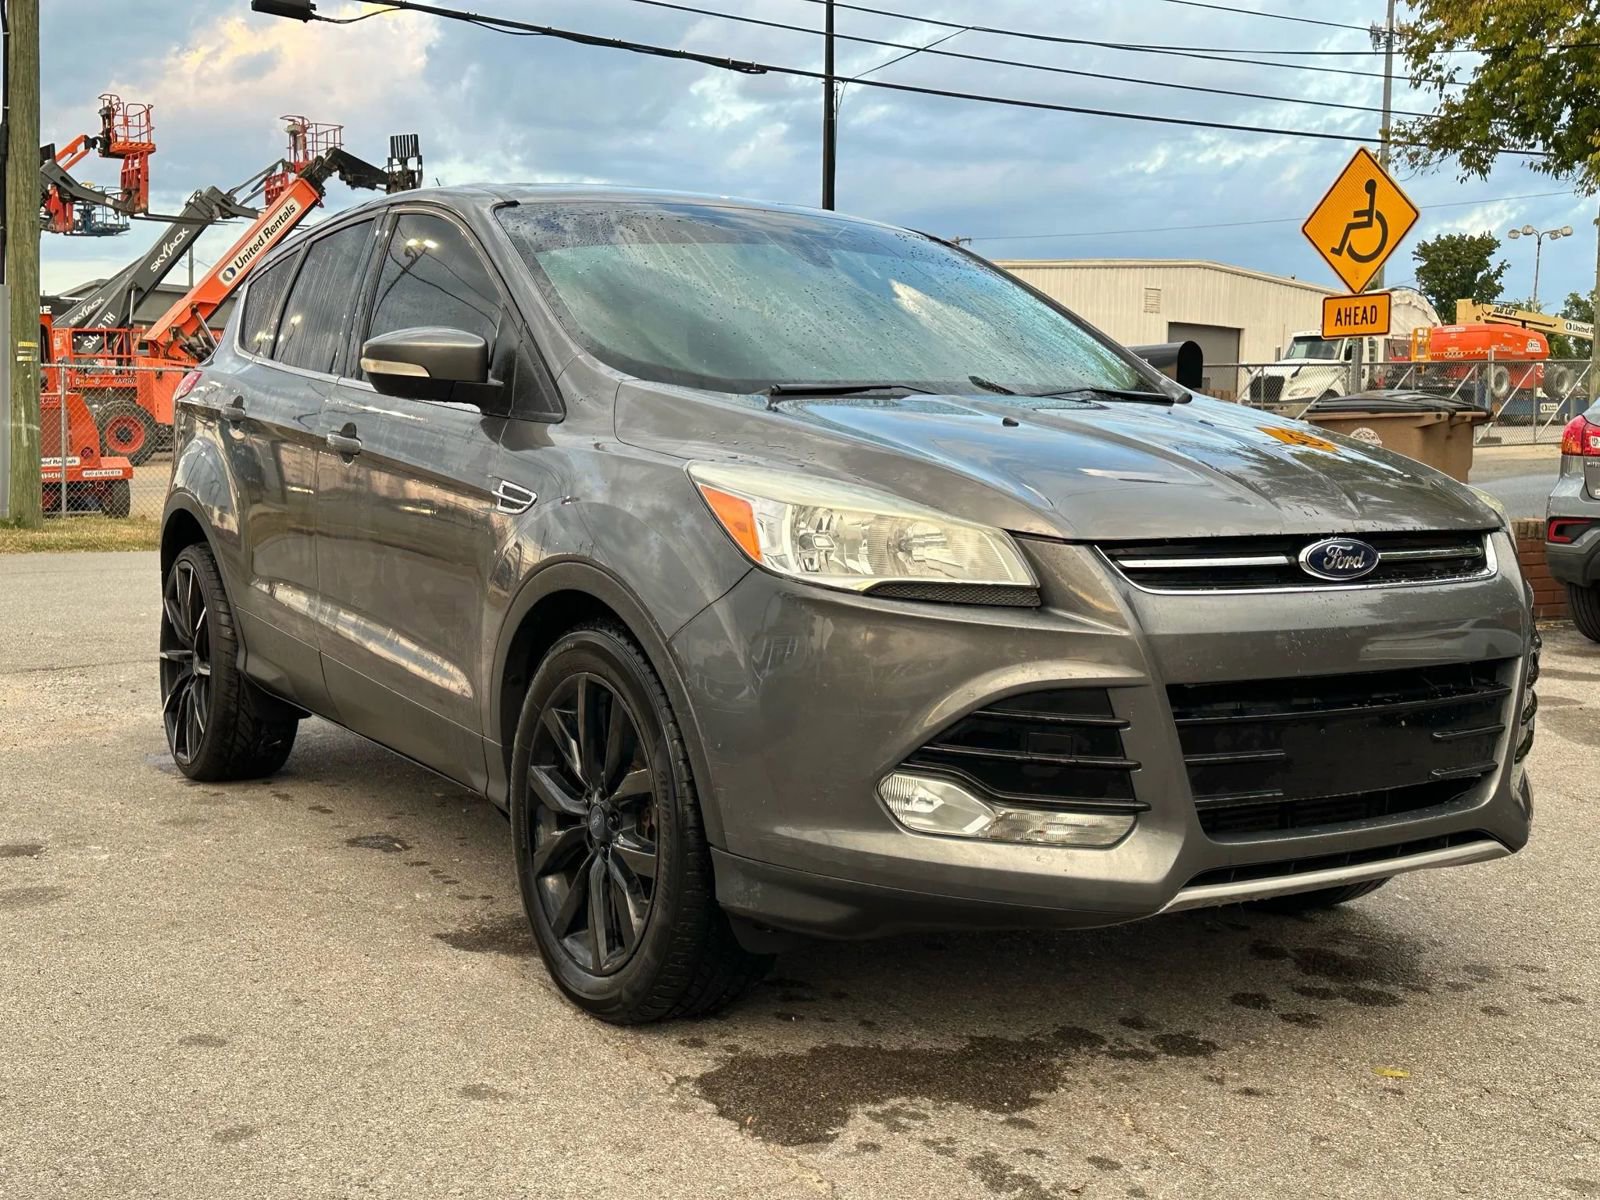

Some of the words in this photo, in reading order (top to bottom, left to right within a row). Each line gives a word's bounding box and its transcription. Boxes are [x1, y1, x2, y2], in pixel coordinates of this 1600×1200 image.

[150, 227, 190, 273] SKYJACK
[234, 236, 266, 271] United
[263, 203, 297, 240] Rentals
[1334, 305, 1378, 327] AHEAD
[1323, 544, 1365, 570] Ford
